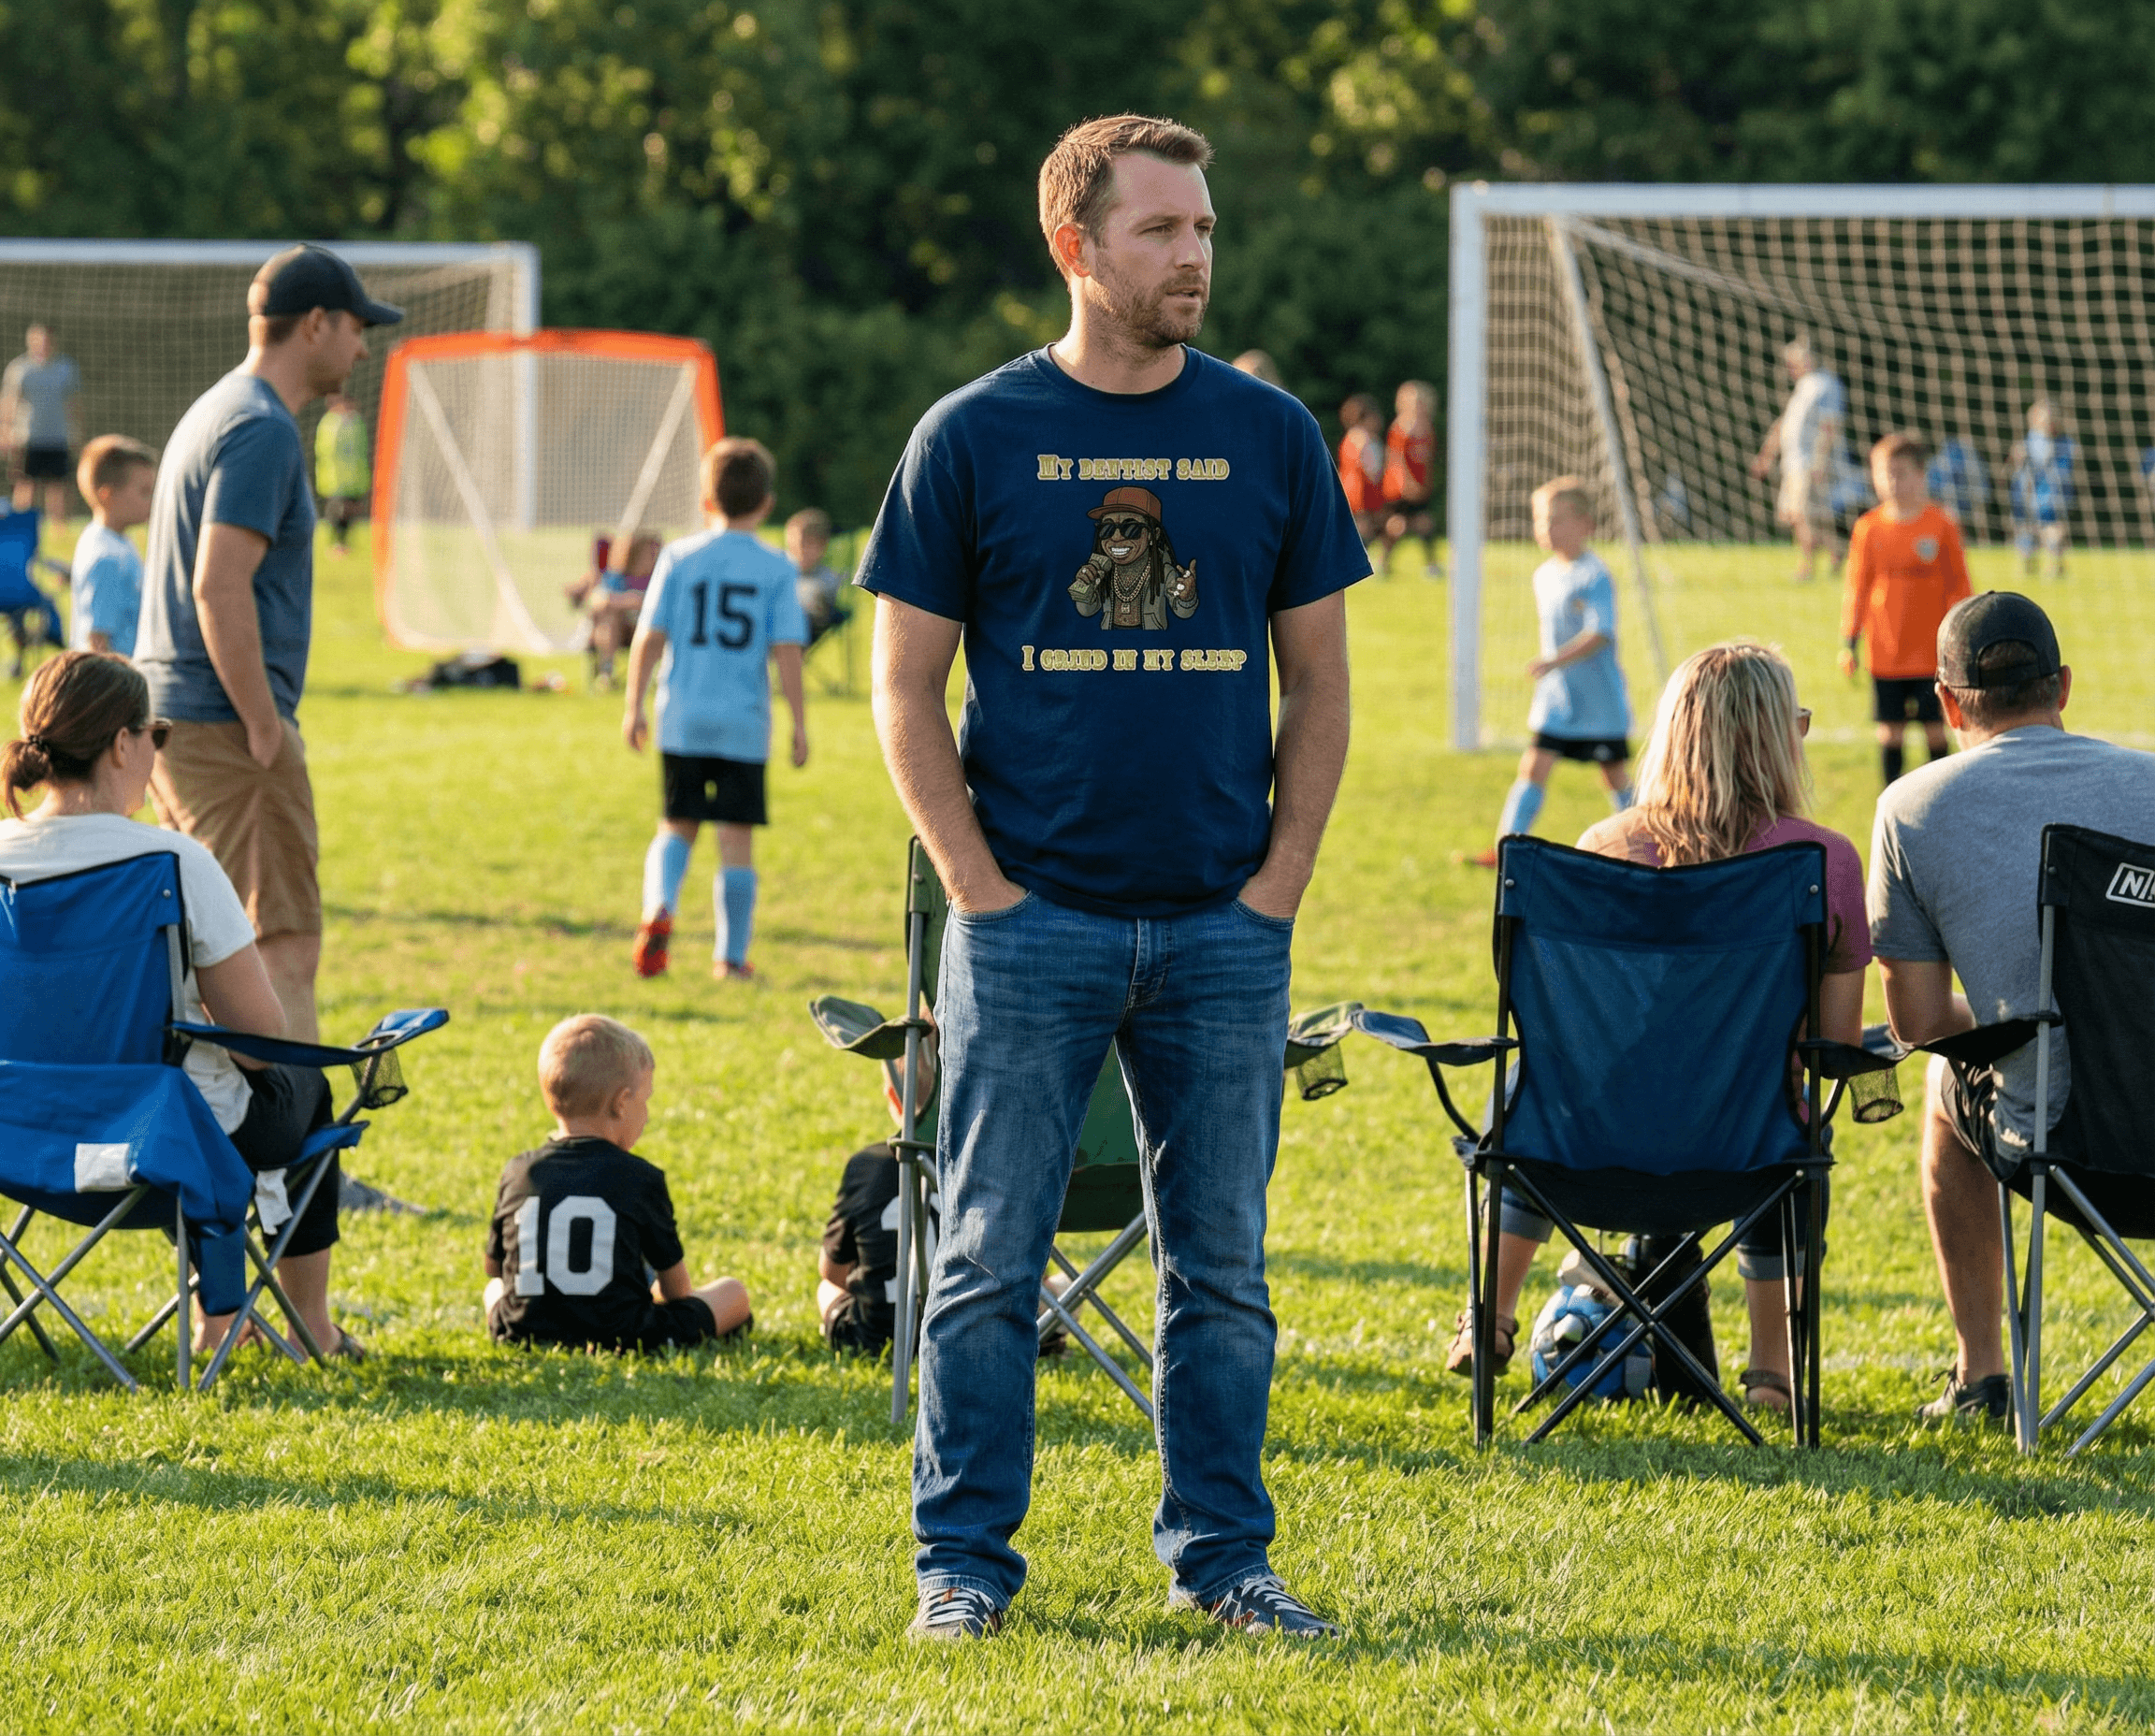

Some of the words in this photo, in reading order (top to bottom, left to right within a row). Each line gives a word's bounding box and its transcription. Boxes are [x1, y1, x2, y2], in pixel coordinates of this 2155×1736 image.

[690, 580, 759, 649] 15
[1021, 645, 1034, 671] I
[513, 1194, 617, 1296] 10
